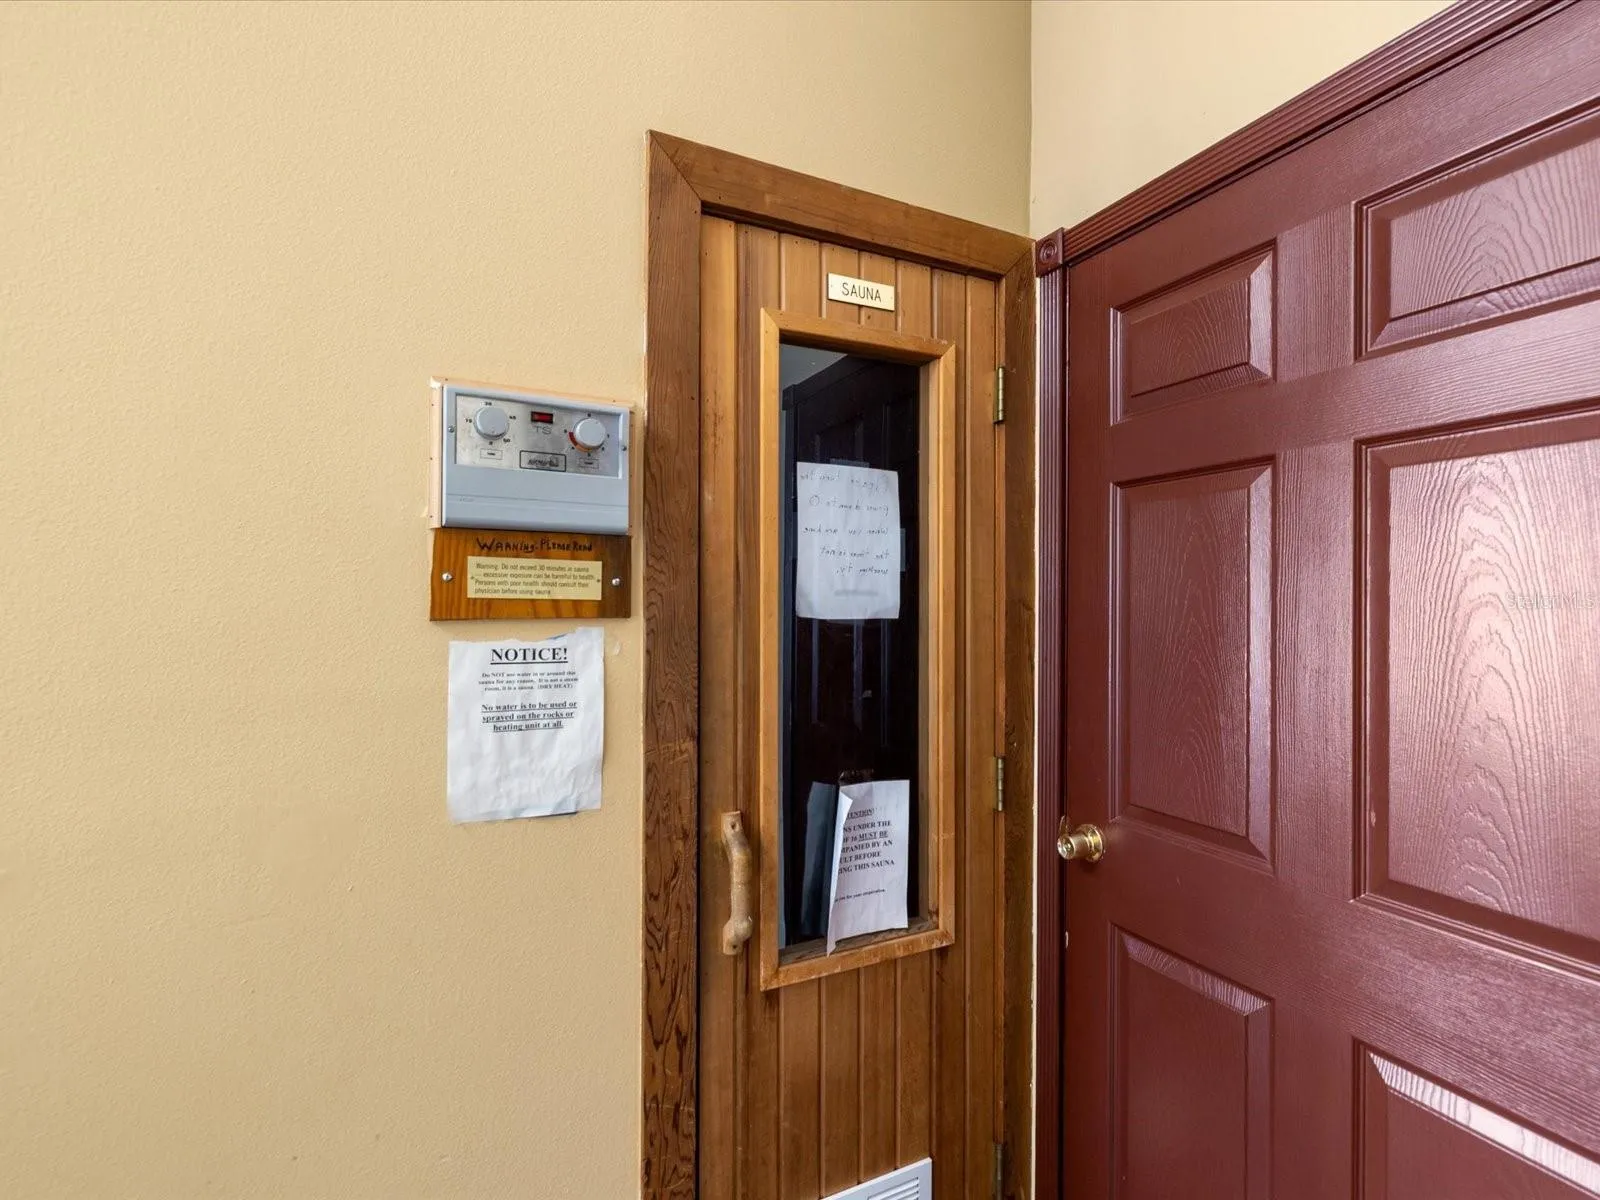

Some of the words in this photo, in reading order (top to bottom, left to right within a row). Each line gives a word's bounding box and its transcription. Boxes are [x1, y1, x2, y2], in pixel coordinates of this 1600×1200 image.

[842, 282, 882, 302] SAUNA
[534, 426, 552, 435] TS
[491, 648, 568, 662] NOTICE!
[482, 712, 515, 723] sprayed
[528, 712, 541, 720] the
[542, 710, 564, 718] rocks
[493, 724, 524, 732] heating
[847, 808, 875, 820] TENTION!
[852, 821, 876, 831] UNDER
[877, 820, 891, 828] THE
[859, 831, 878, 841] MUST
[879, 830, 888, 838] BE
[842, 842, 870, 852] PANIED
[872, 840, 880, 848] BY
[882, 839, 893, 847] AN
[840, 855, 853, 864] ULT
[854, 851, 880, 861] BEFORE
[838, 865, 853, 874] ING
[854, 862, 870, 870] THIS
[871, 859, 895, 868] SAUNA
